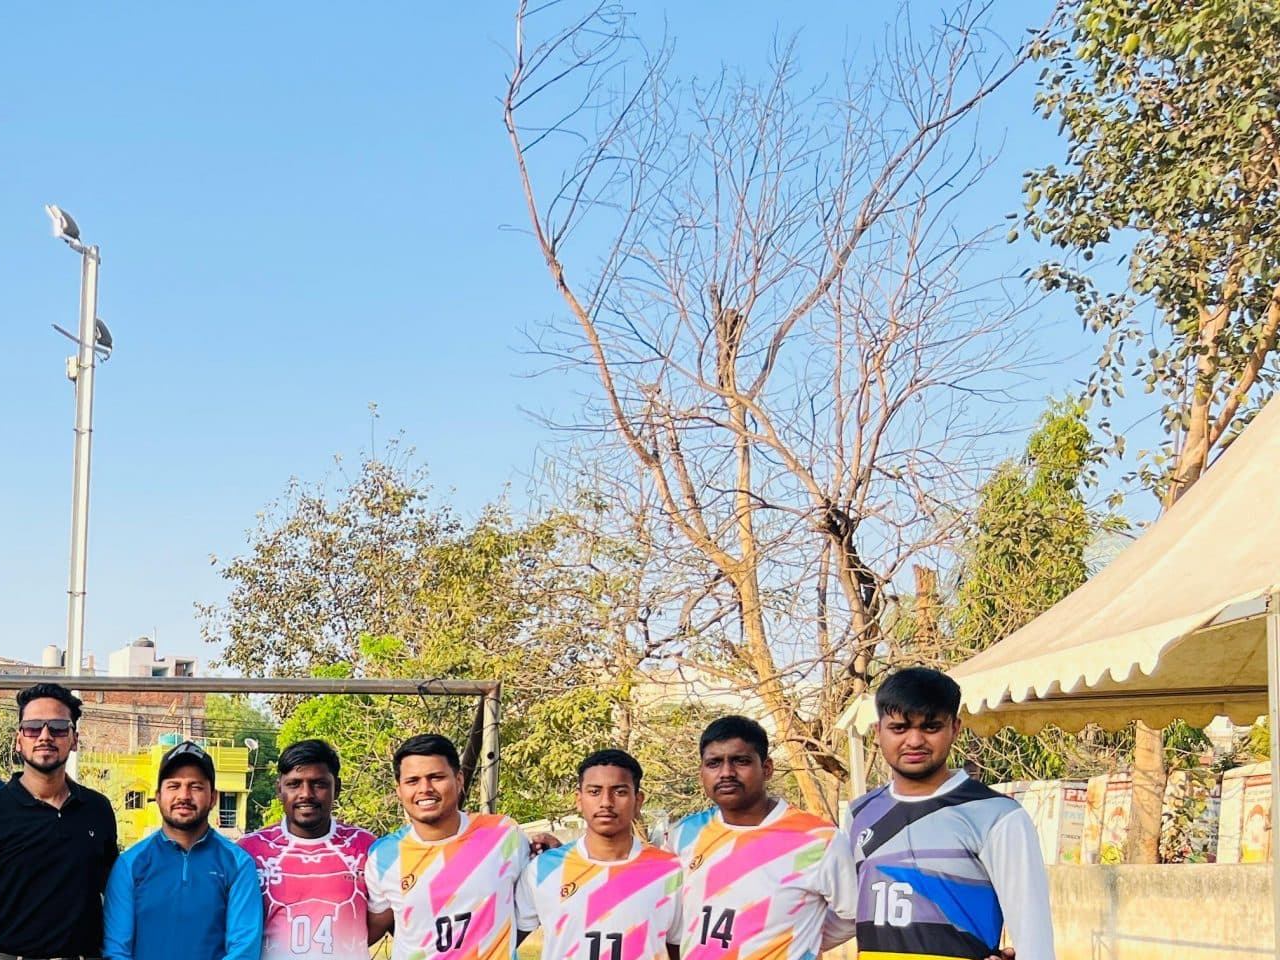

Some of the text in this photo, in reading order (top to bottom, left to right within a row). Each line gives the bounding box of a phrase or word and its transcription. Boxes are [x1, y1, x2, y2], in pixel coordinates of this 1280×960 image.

[871, 881, 914, 927] 16
[291, 915, 334, 954] 04
[435, 911, 472, 953] 07
[700, 905, 736, 949] 14
